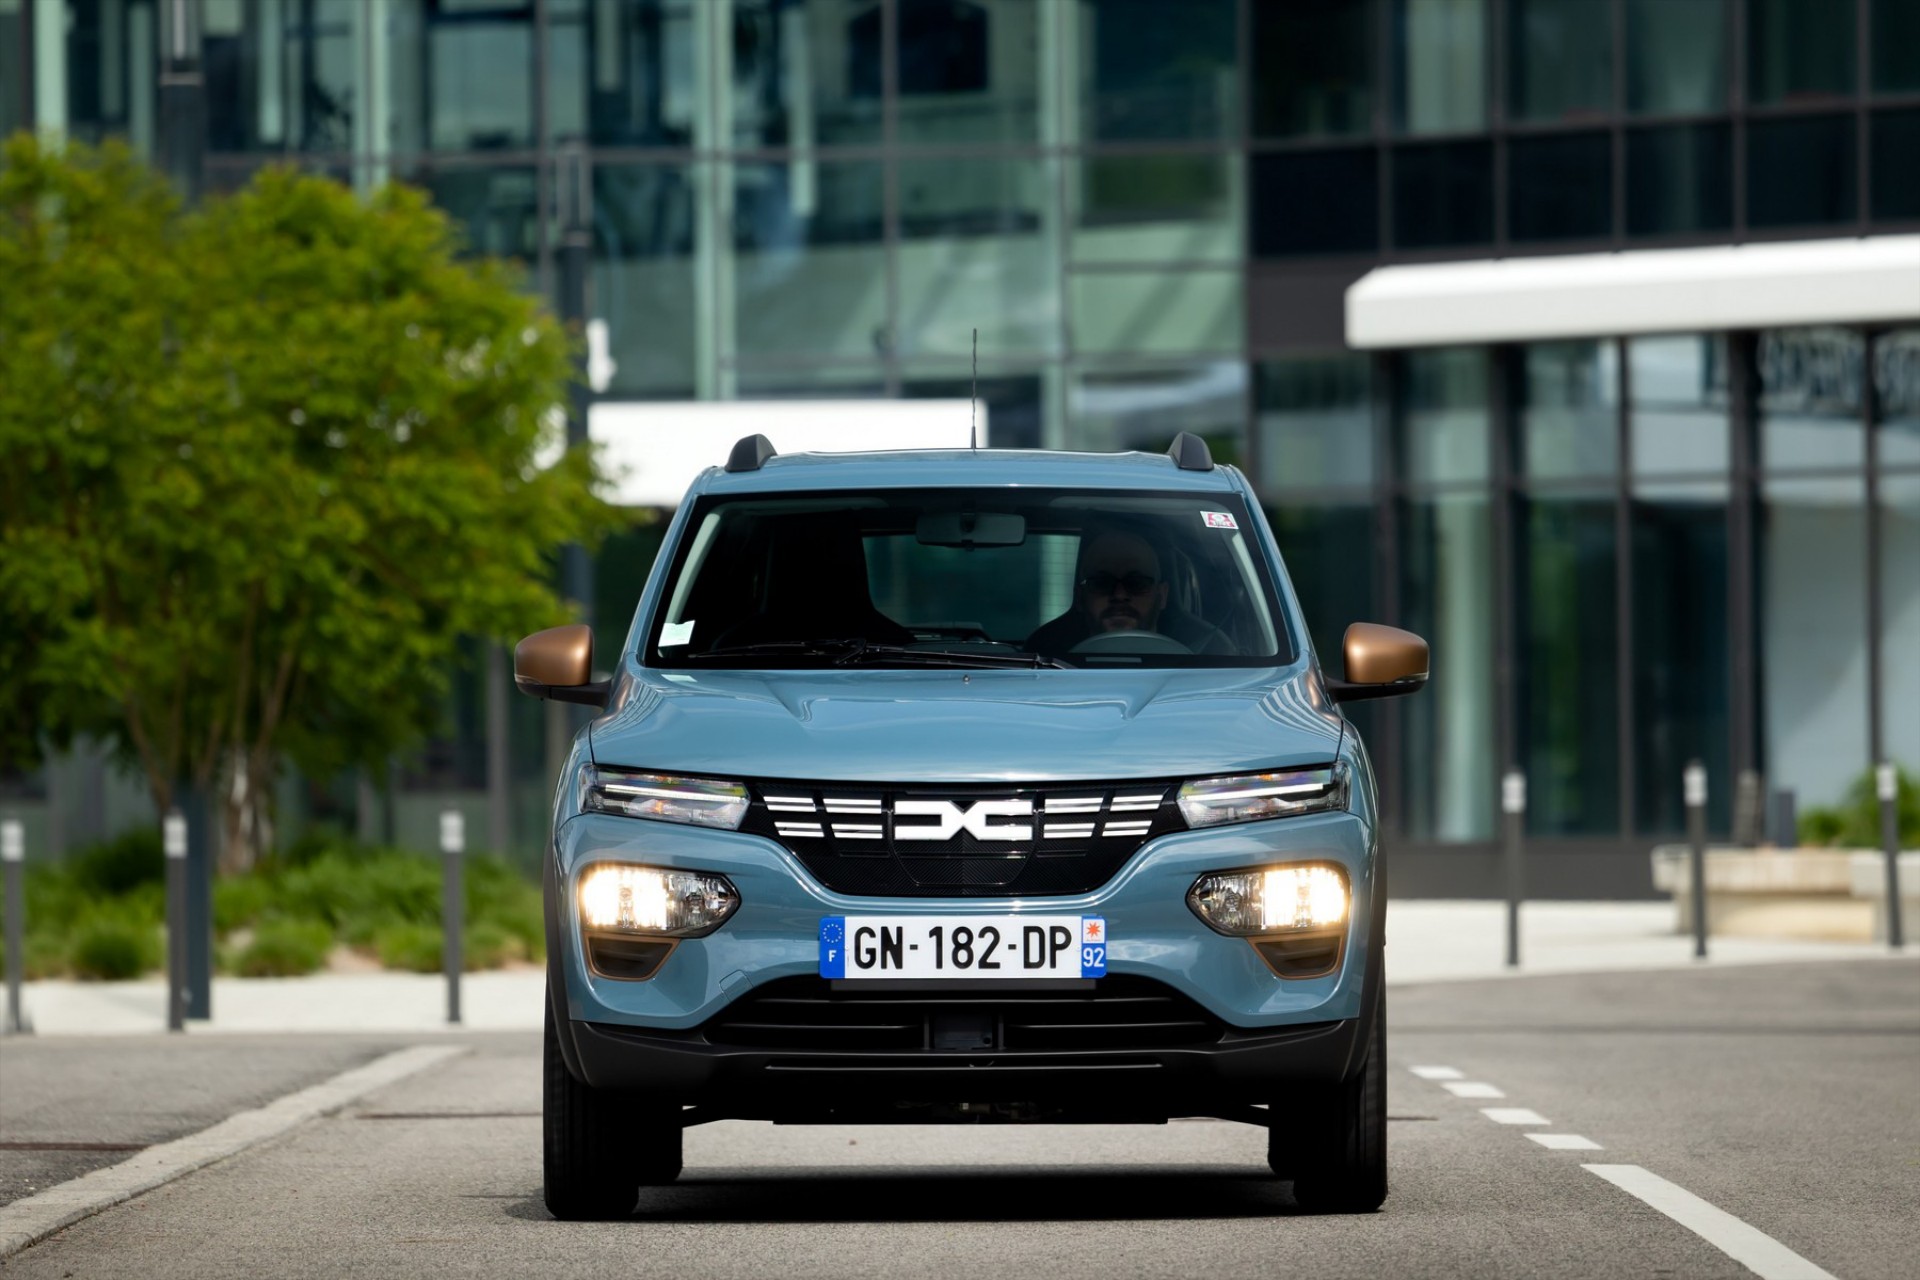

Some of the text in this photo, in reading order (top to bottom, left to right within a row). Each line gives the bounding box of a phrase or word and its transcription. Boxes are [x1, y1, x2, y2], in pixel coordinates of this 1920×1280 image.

[828, 949, 837, 963] F
[854, 926, 1072, 969] GN-182-DP
[1083, 947, 1105, 968] 92
